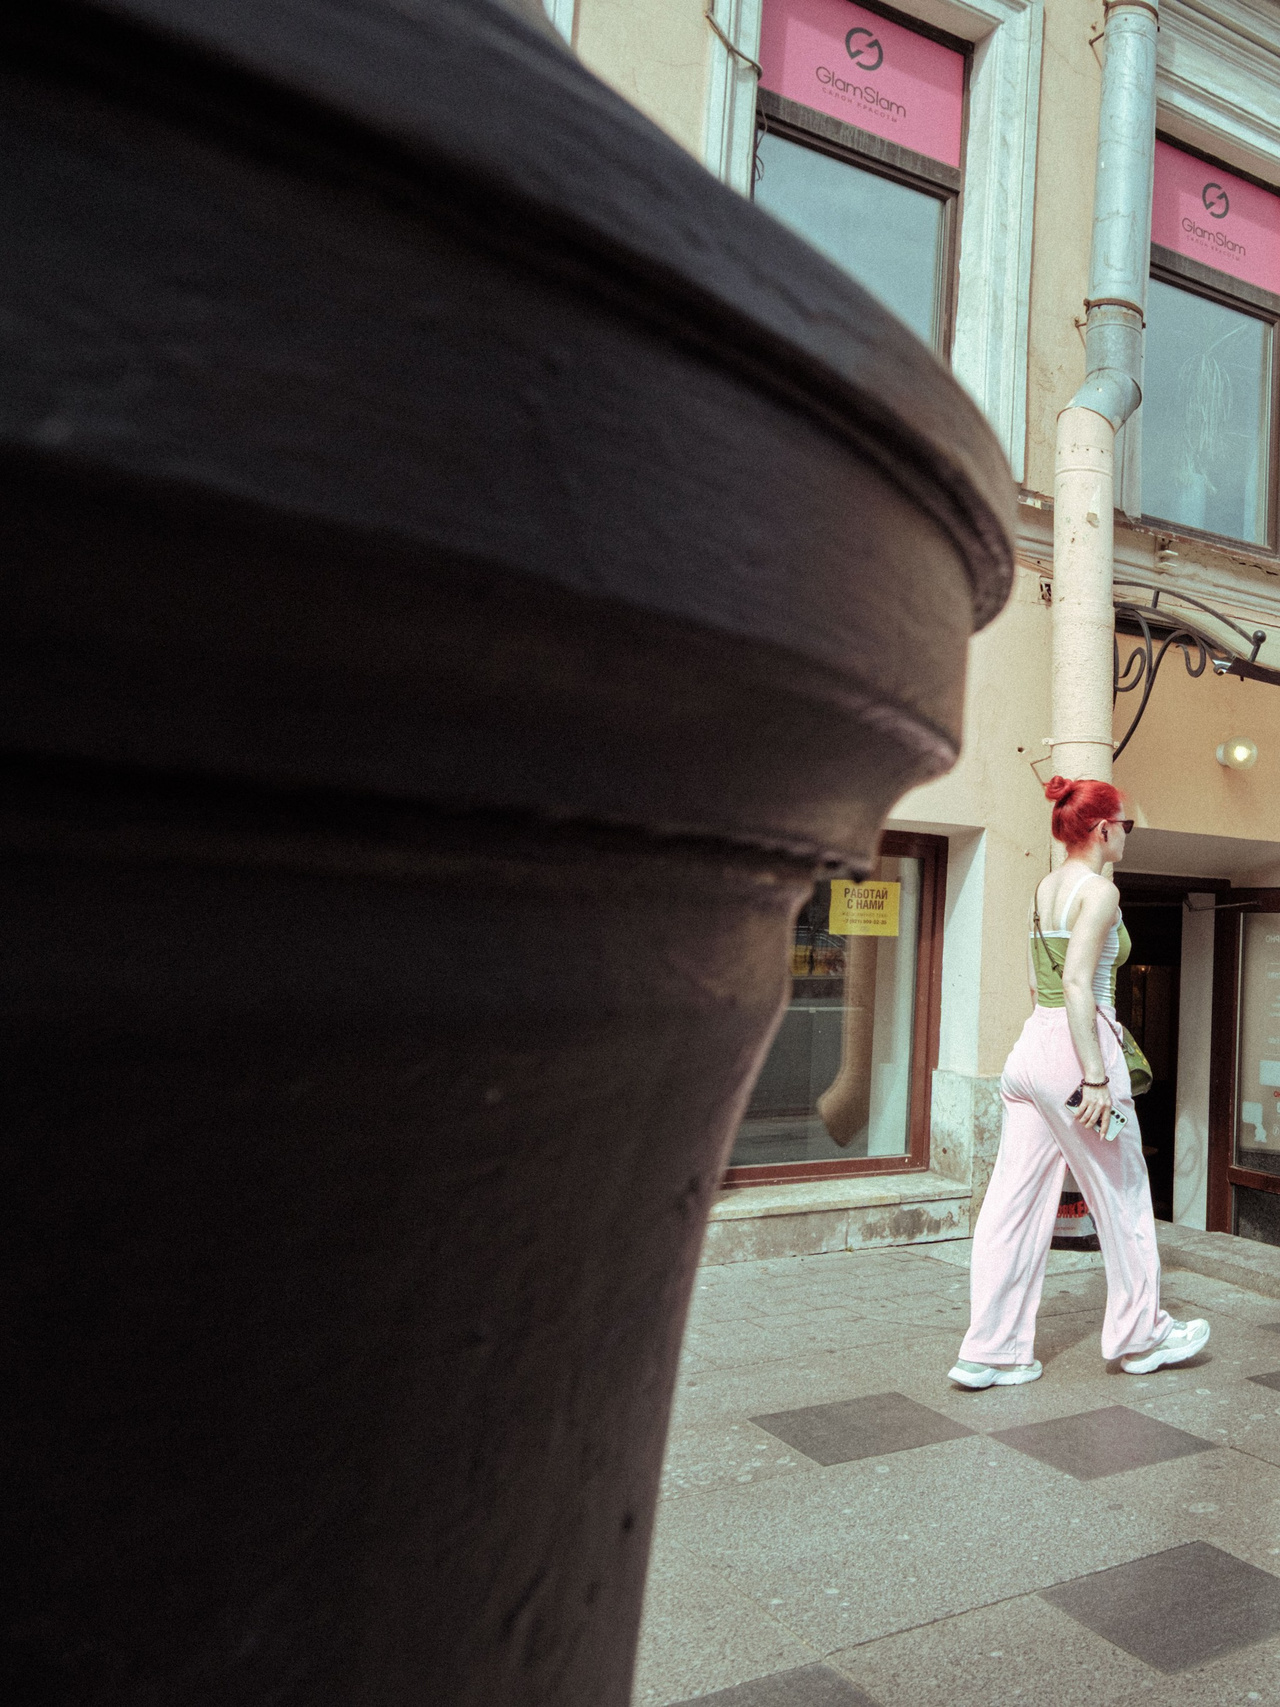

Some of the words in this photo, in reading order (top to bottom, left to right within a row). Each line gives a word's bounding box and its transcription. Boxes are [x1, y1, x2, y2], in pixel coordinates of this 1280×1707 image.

[815, 66, 906, 118] GlamSlam
[1181, 217, 1246, 257] GlamSlam
[844, 887, 888, 900] РАБОТАЙ
[847, 899, 854, 909] С
[856, 900, 884, 910] НАМИ
